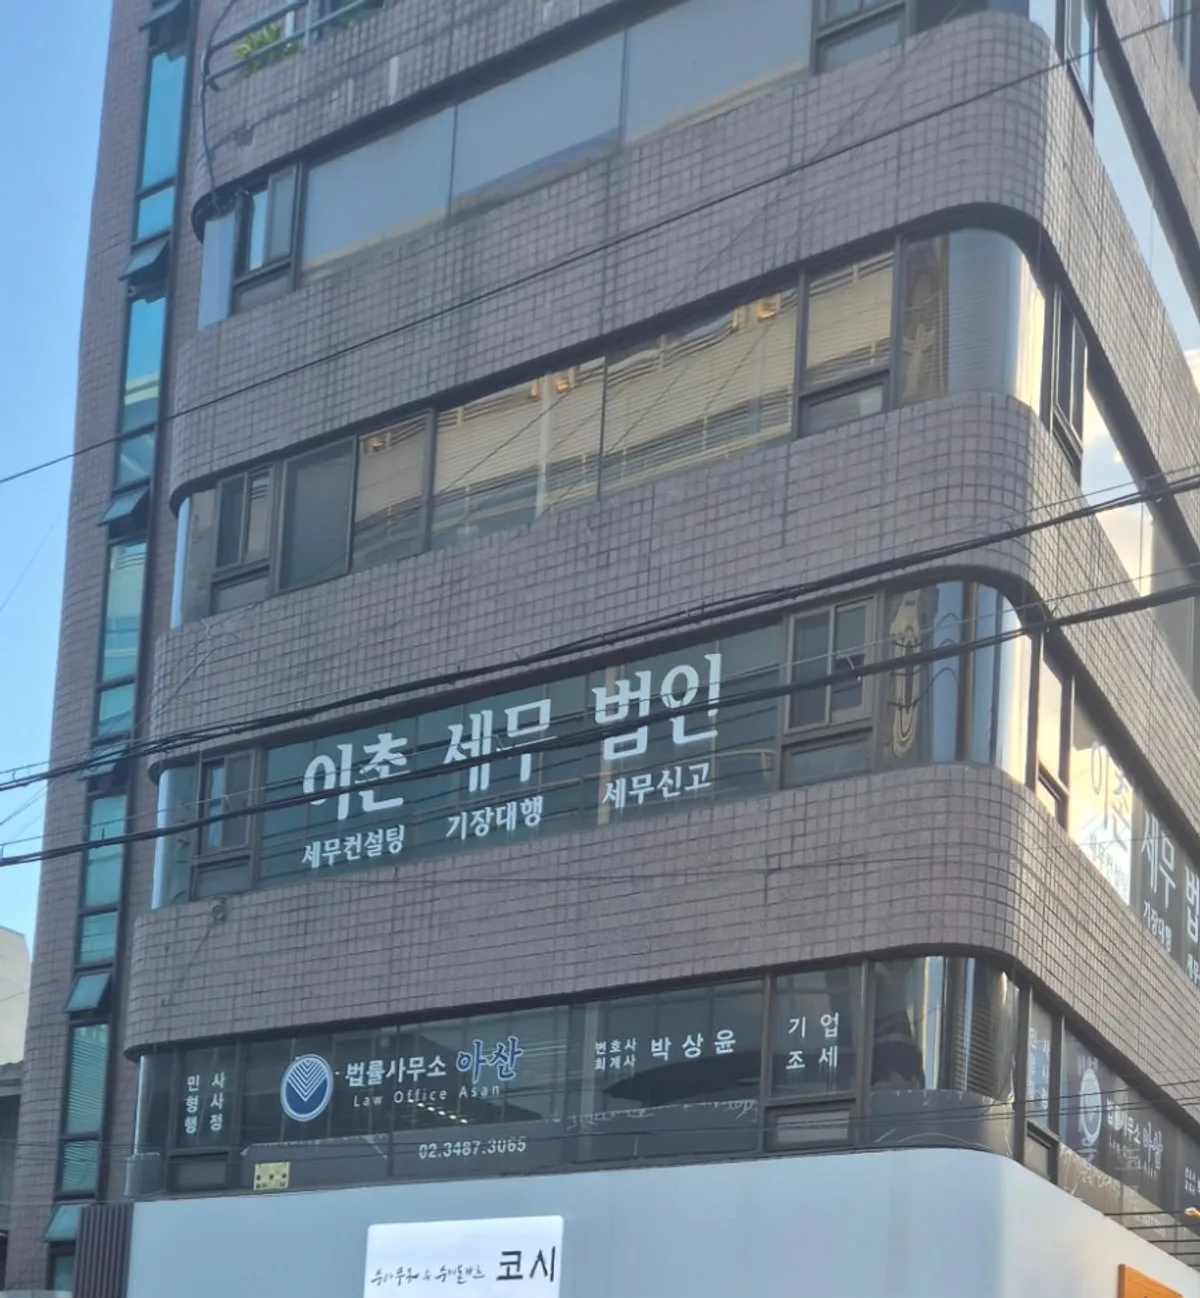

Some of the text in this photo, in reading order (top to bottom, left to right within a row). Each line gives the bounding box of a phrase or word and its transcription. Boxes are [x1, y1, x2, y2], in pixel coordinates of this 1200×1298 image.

[302, 653, 722, 822] 이촌 세무 법인
[301, 762, 712, 869] 세무컨설팅 기장대행 세무신고
[1140, 810, 1176, 909] 세무
[345, 1035, 523, 1088] 법률사무소 아산
[594, 1054, 637, 1072] 회계사
[595, 1028, 736, 1059] 변호사 박상윤
[354, 1083, 501, 1108] Law Office Asan
[1107, 1097, 1142, 1146] 법무소
[418, 1135, 528, 1161] 02.3487.3065
[496, 1246, 557, 1283] 코시
